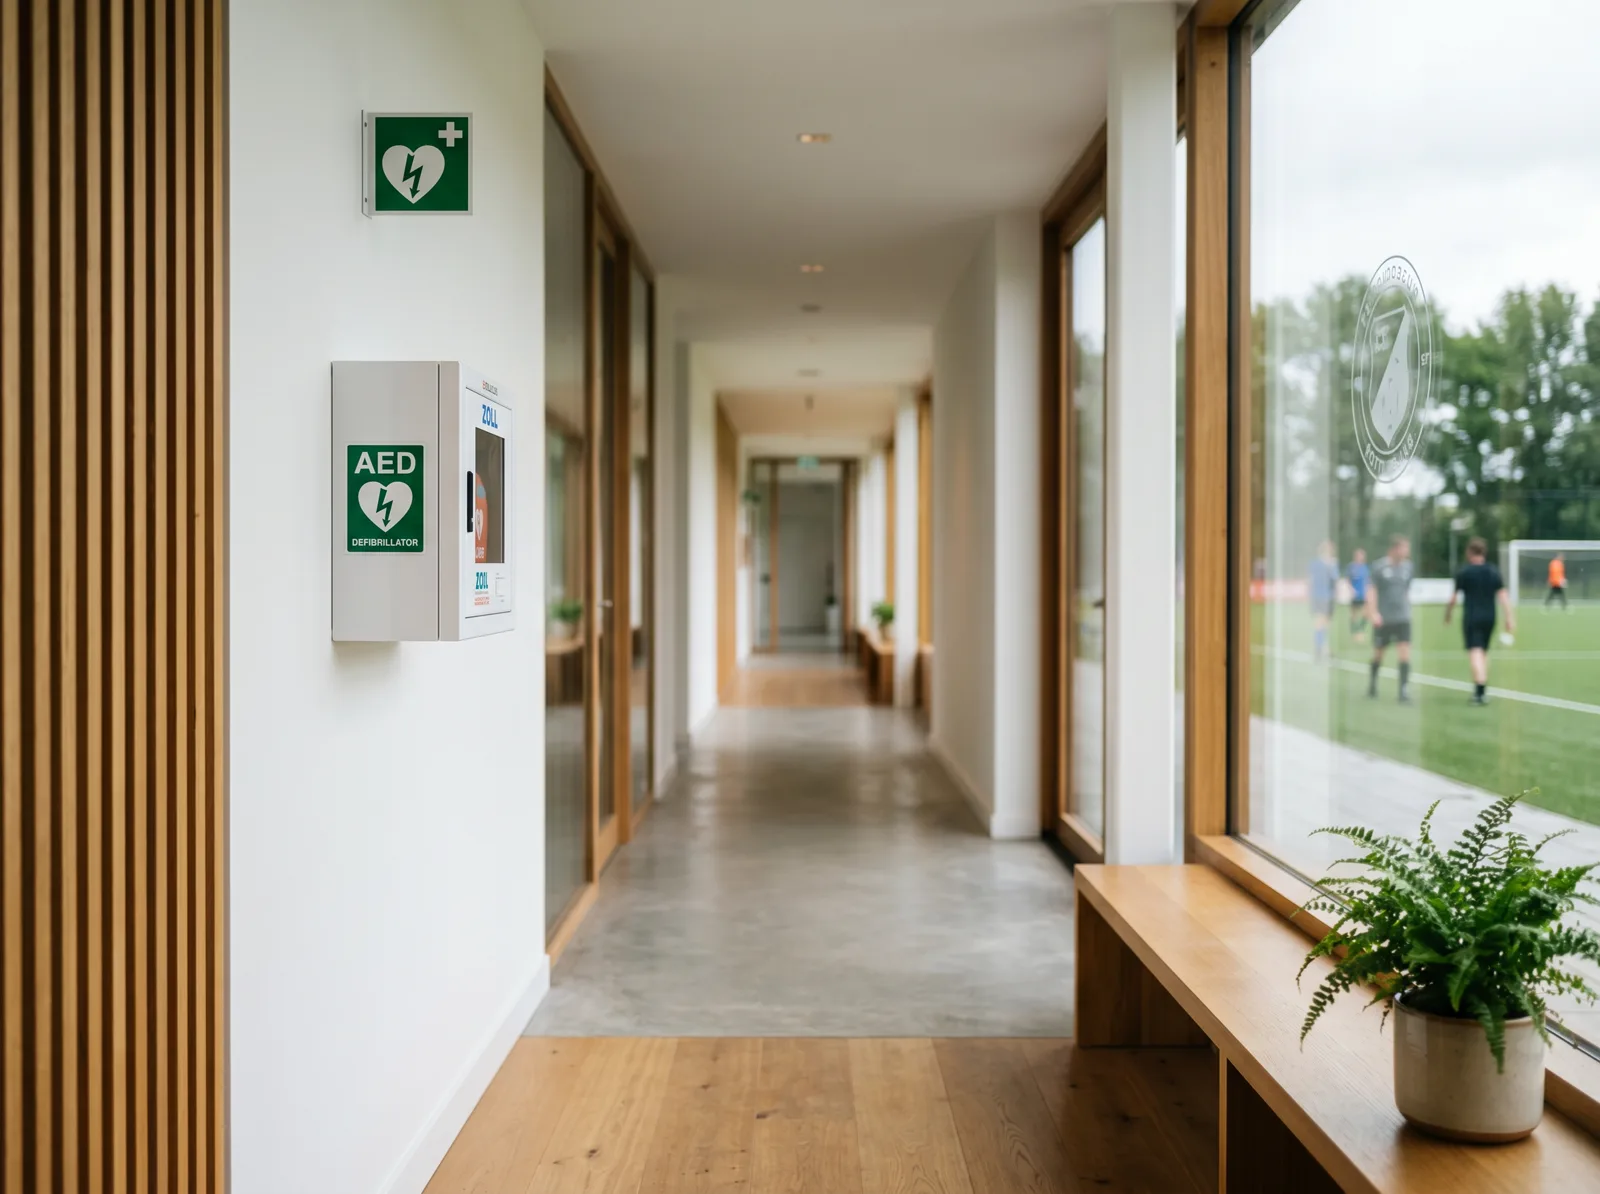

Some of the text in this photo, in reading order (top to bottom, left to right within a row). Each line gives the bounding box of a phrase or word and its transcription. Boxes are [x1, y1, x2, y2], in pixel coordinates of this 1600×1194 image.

[481, 404, 499, 429] ZOLL
[354, 451, 416, 474] AED
[352, 538, 418, 547] DEFIBRILLATOR
